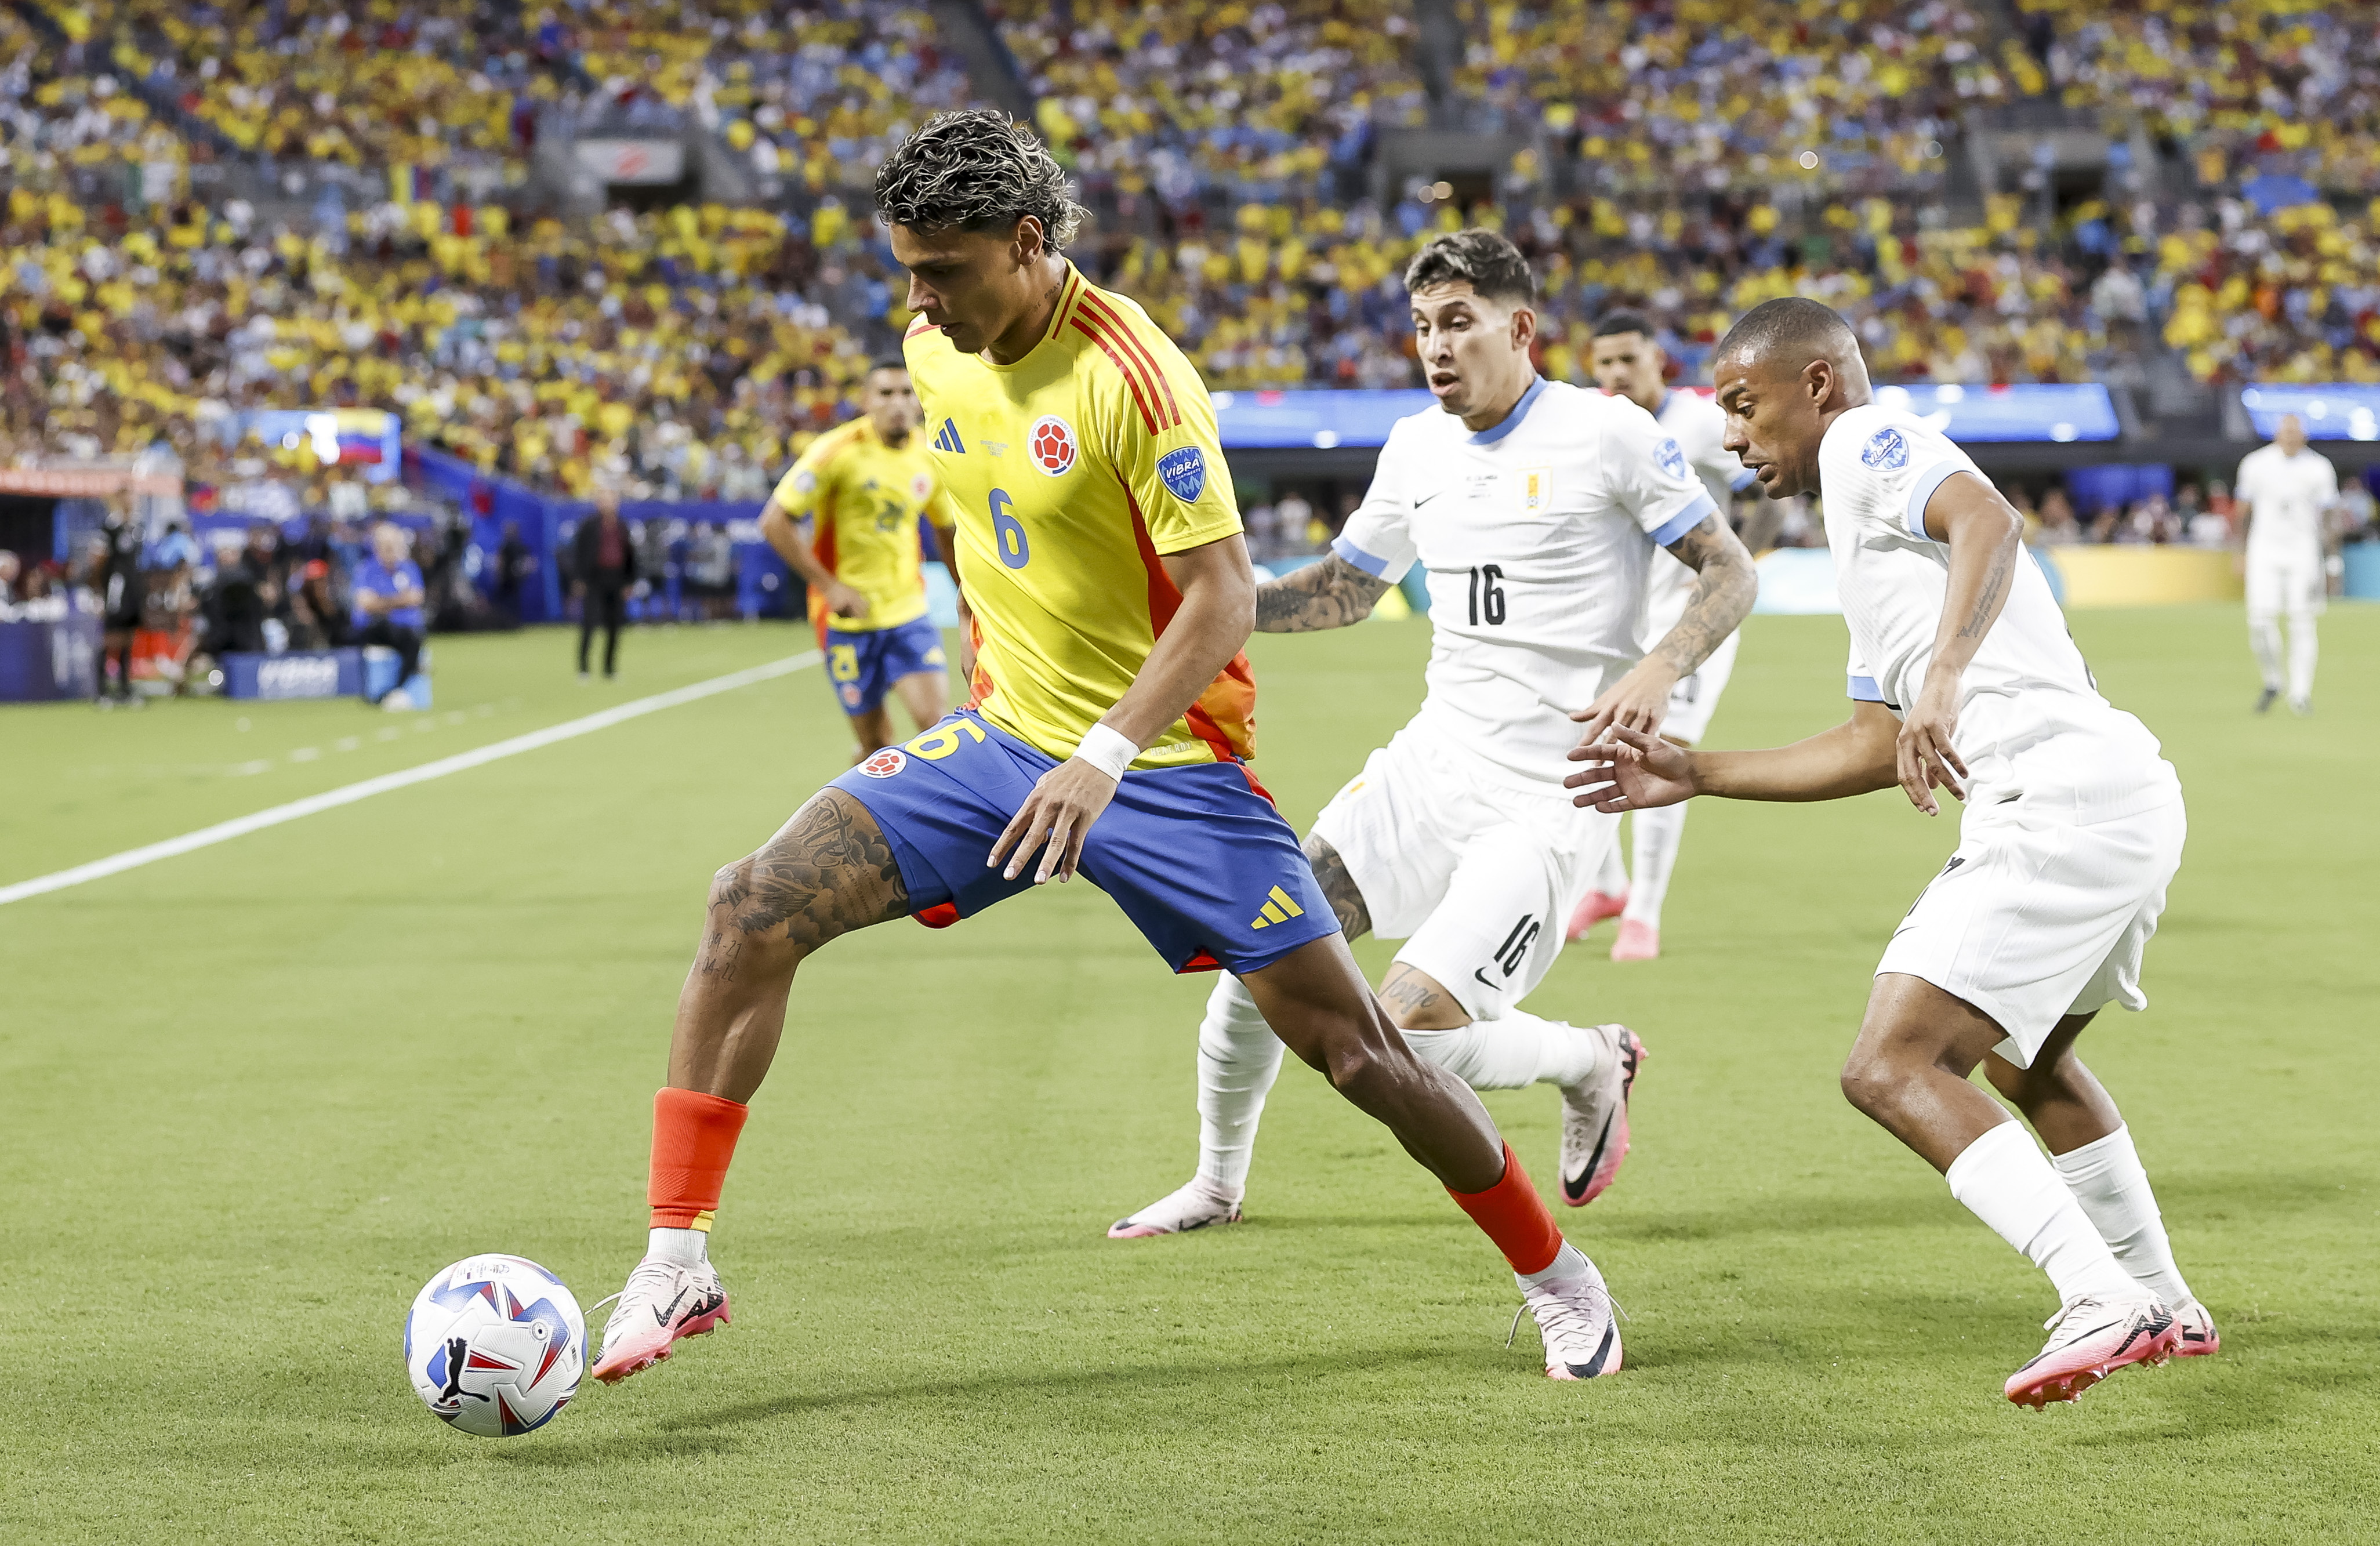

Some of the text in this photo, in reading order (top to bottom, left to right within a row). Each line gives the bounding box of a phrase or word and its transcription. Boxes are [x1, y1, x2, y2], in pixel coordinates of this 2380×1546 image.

[1166, 458, 1200, 478] VIBRA
[1175, 467, 1201, 481] CONTINENTE
[988, 488, 1029, 569] 6
[1469, 564, 1505, 626] 16
[904, 717, 986, 760] 6
[1493, 913, 1540, 978] 16
